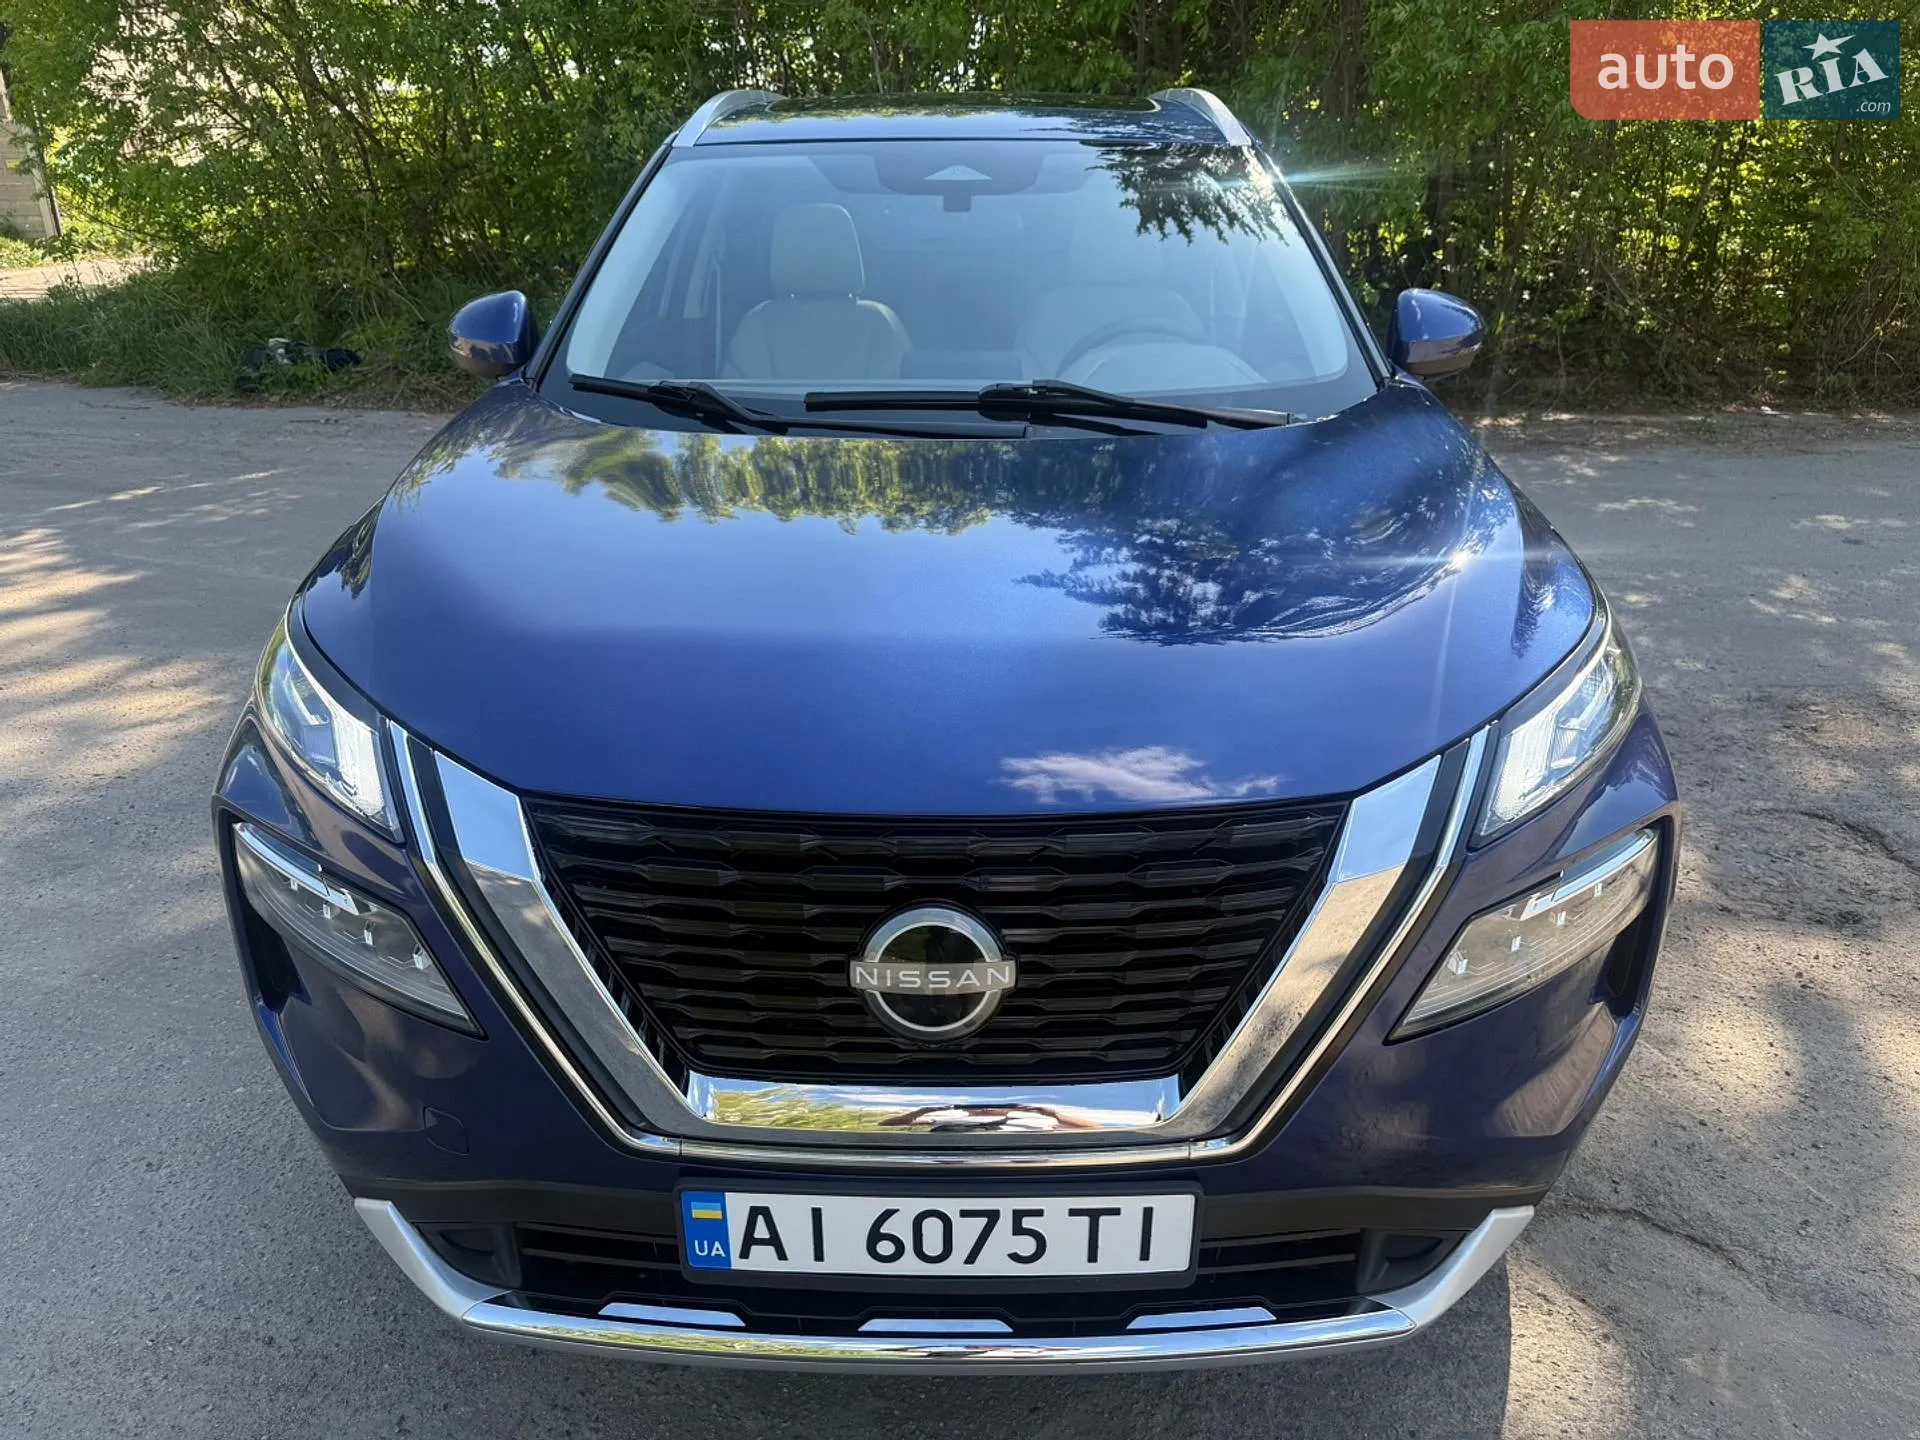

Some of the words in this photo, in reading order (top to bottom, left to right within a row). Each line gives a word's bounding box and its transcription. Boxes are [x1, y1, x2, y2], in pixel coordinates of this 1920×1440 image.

[855, 966, 1009, 988] NISSAN
[738, 1206, 825, 1262] AI
[865, 1208, 1047, 1265] 6075
[1068, 1206, 1154, 1263] TI
[694, 1240, 726, 1257] UA
